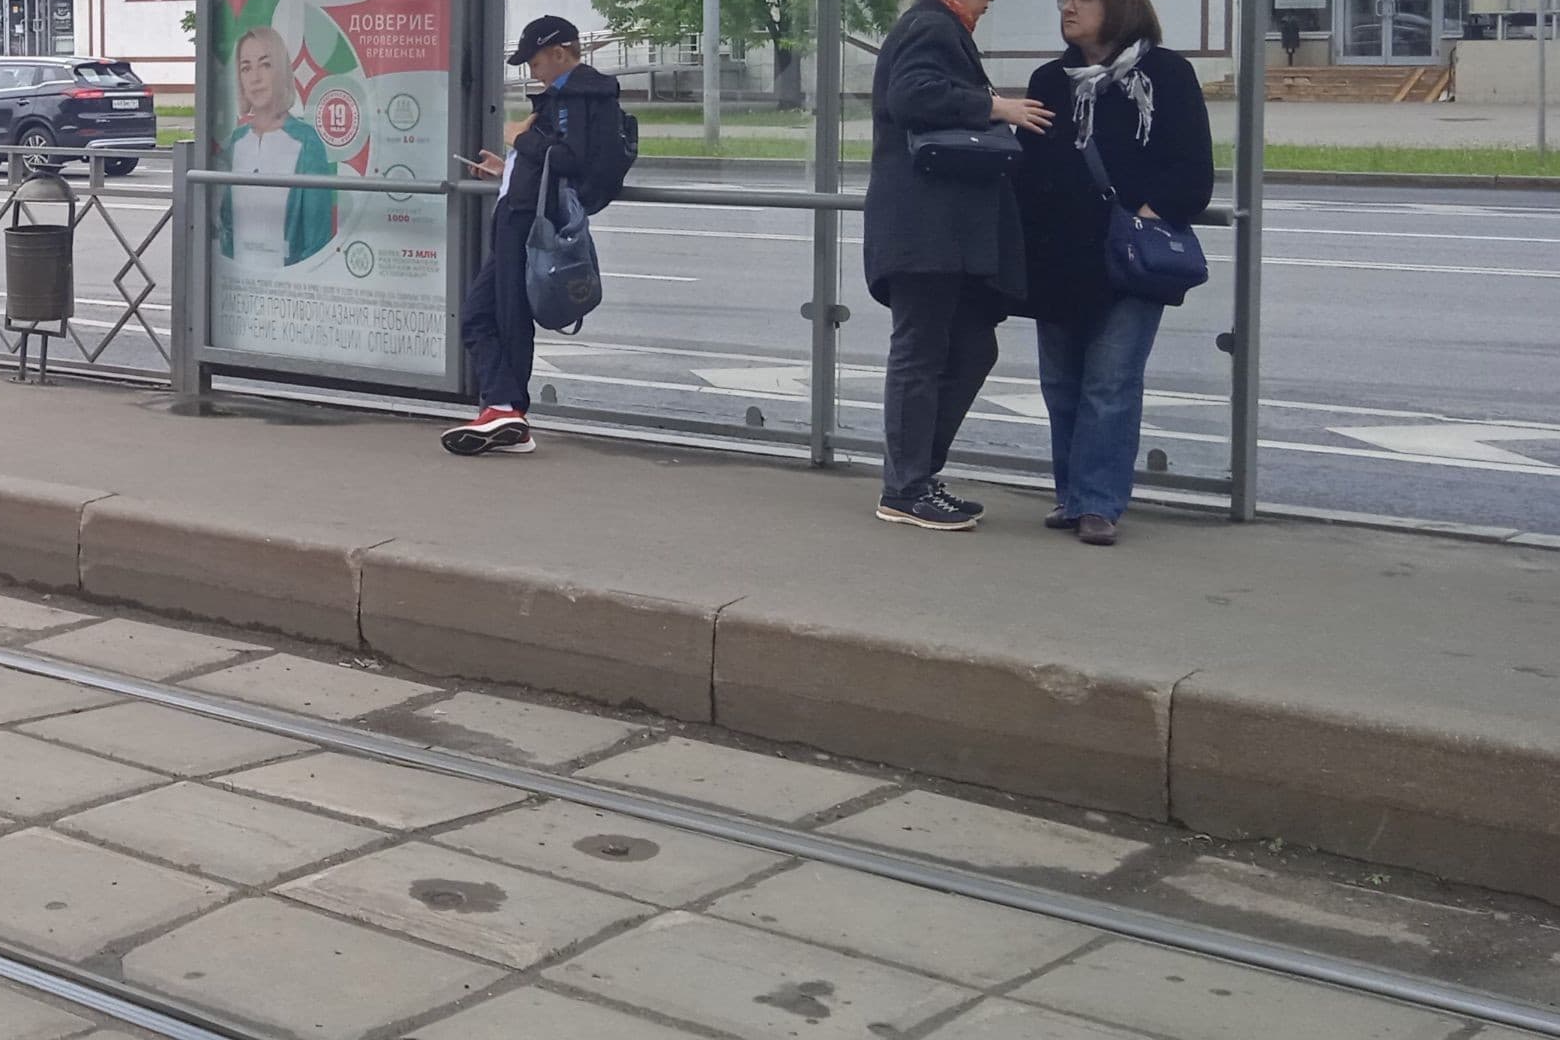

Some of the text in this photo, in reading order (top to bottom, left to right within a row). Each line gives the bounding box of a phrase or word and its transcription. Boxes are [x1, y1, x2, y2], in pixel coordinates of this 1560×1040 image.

[359, 35, 438, 46] ПРОВЕРЕННОЕ
[328, 103, 346, 127] 19
[403, 135, 415, 144] 10
[387, 214, 410, 222] 1000
[401, 249, 414, 258] 73
[415, 250, 437, 259] МЛН
[267, 296, 369, 328] ПРОТИВОПОКАЗАНИЯ
[281, 321, 361, 352] КОНСУЛЬТАЦИИ
